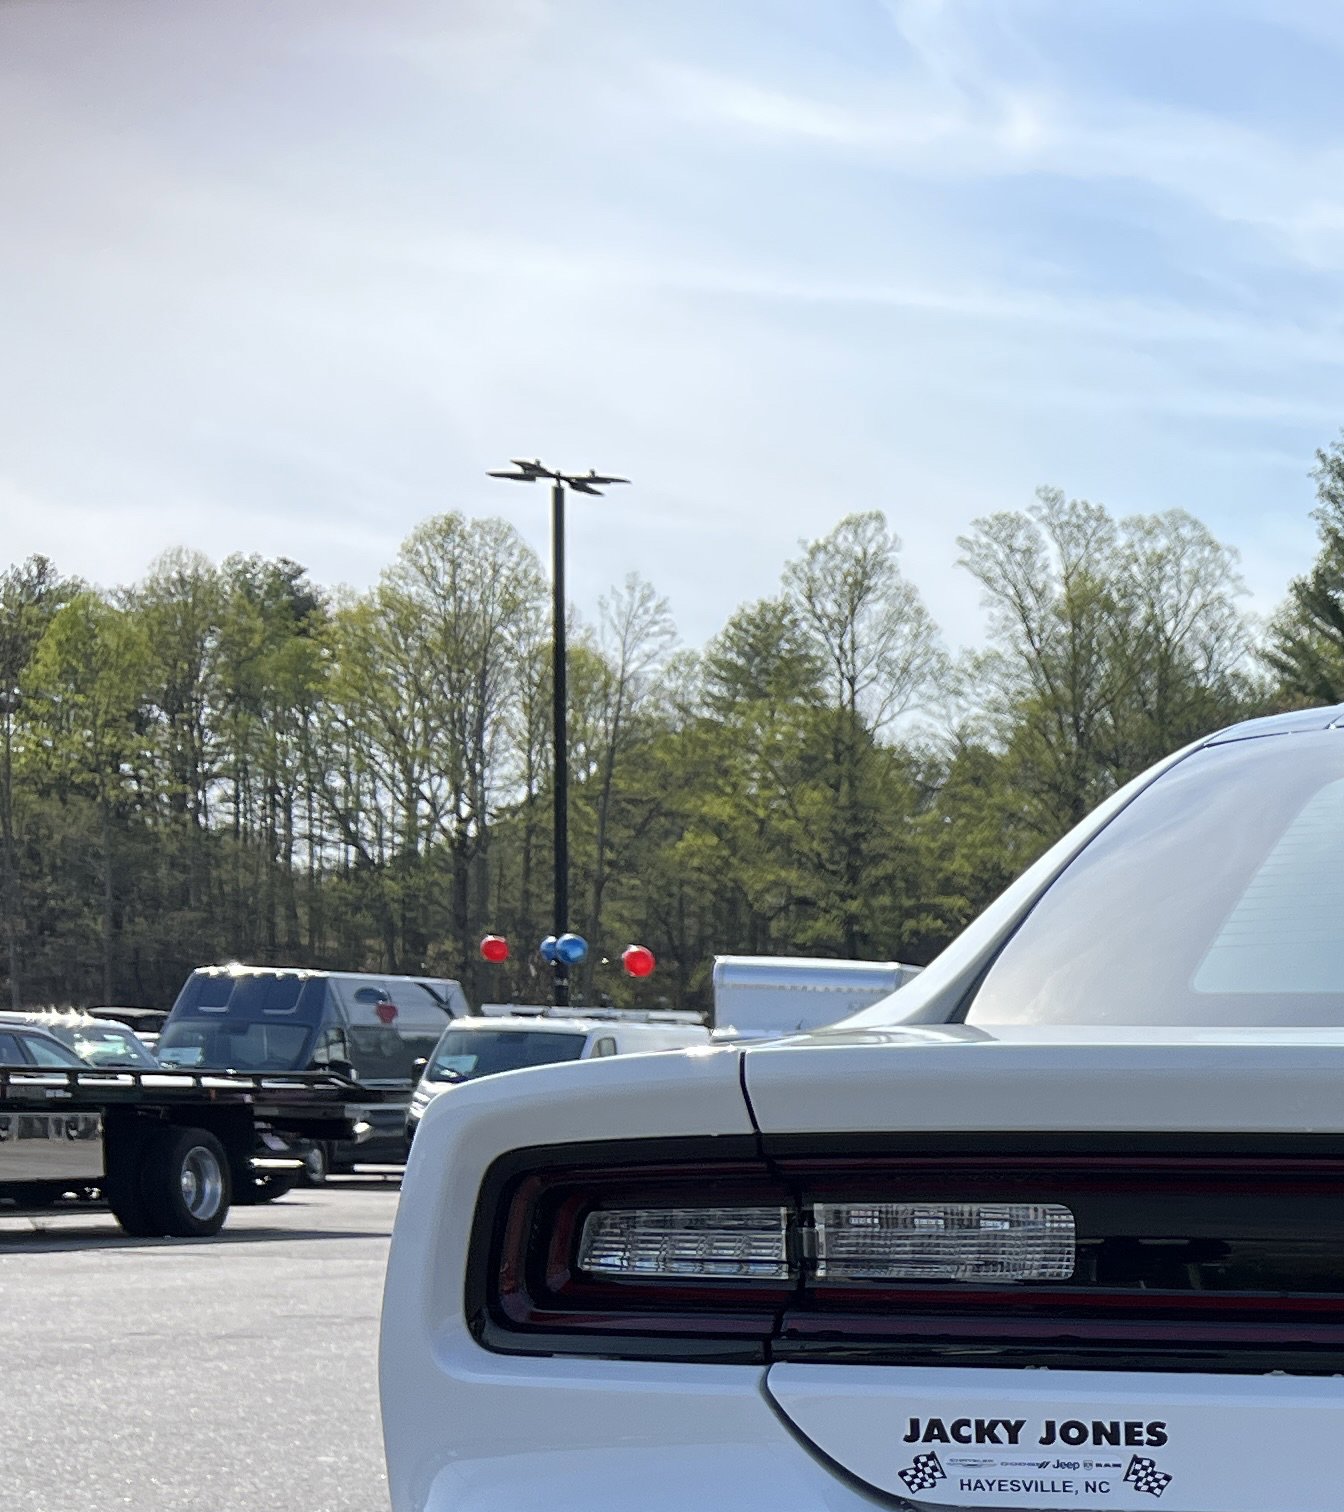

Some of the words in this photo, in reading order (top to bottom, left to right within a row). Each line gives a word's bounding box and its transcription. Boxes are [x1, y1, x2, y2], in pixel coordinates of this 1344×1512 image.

[903, 1417, 1027, 1445] JACKY
[1038, 1419, 1169, 1447] JONES
[1052, 1459, 1081, 1470] Jeep
[959, 1478, 1079, 1496] HAYESVILLE,
[1084, 1480, 1111, 1494] NC
